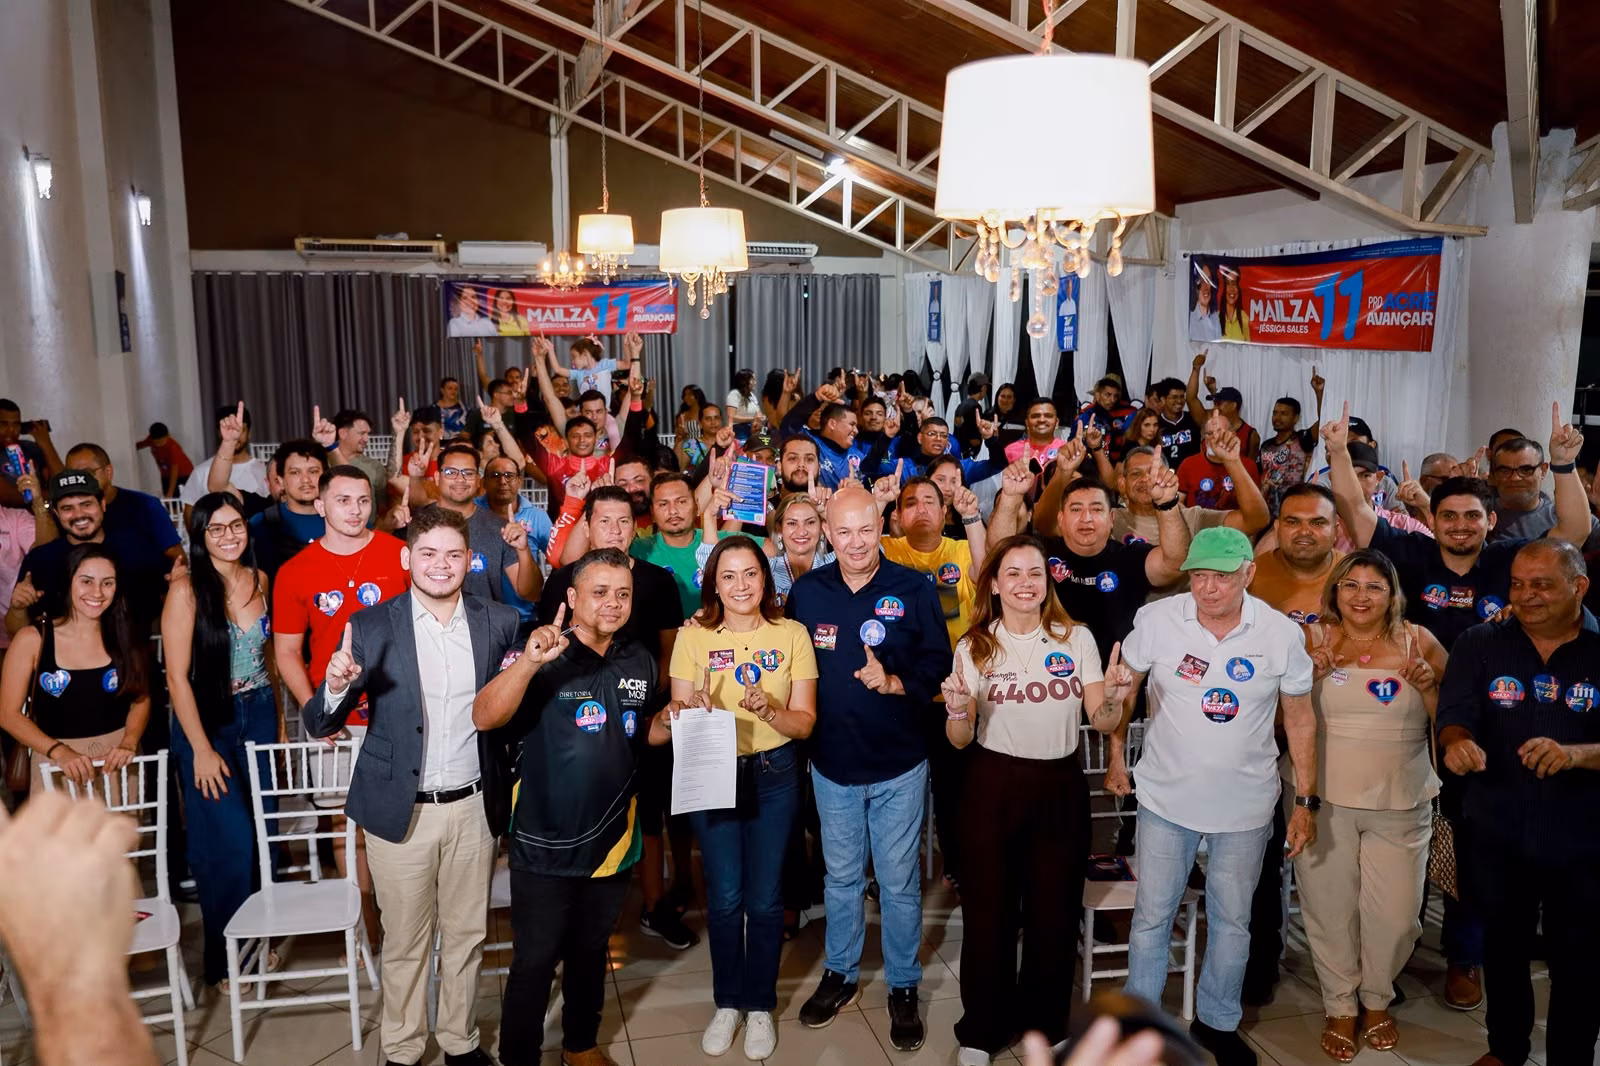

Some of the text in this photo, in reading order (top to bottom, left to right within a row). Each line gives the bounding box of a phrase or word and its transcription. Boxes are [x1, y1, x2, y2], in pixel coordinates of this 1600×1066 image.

[1313, 268, 1364, 341] 11
[1368, 291, 1436, 311] PRO ACRE
[526, 307, 596, 322] MAILZA
[592, 291, 631, 331] 11
[1249, 299, 1321, 323] MAILZA
[1366, 311, 1434, 329] AVANÇAR
[1258, 323, 1309, 334] JÉSSICA SALES
[1170, 445, 1178, 458] 2
[59, 475, 86, 488] REX
[762, 654, 775, 666] 11
[617, 678, 648, 692] ACRE
[987, 676, 1083, 705] 44000
[1375, 681, 1392, 697] 11
